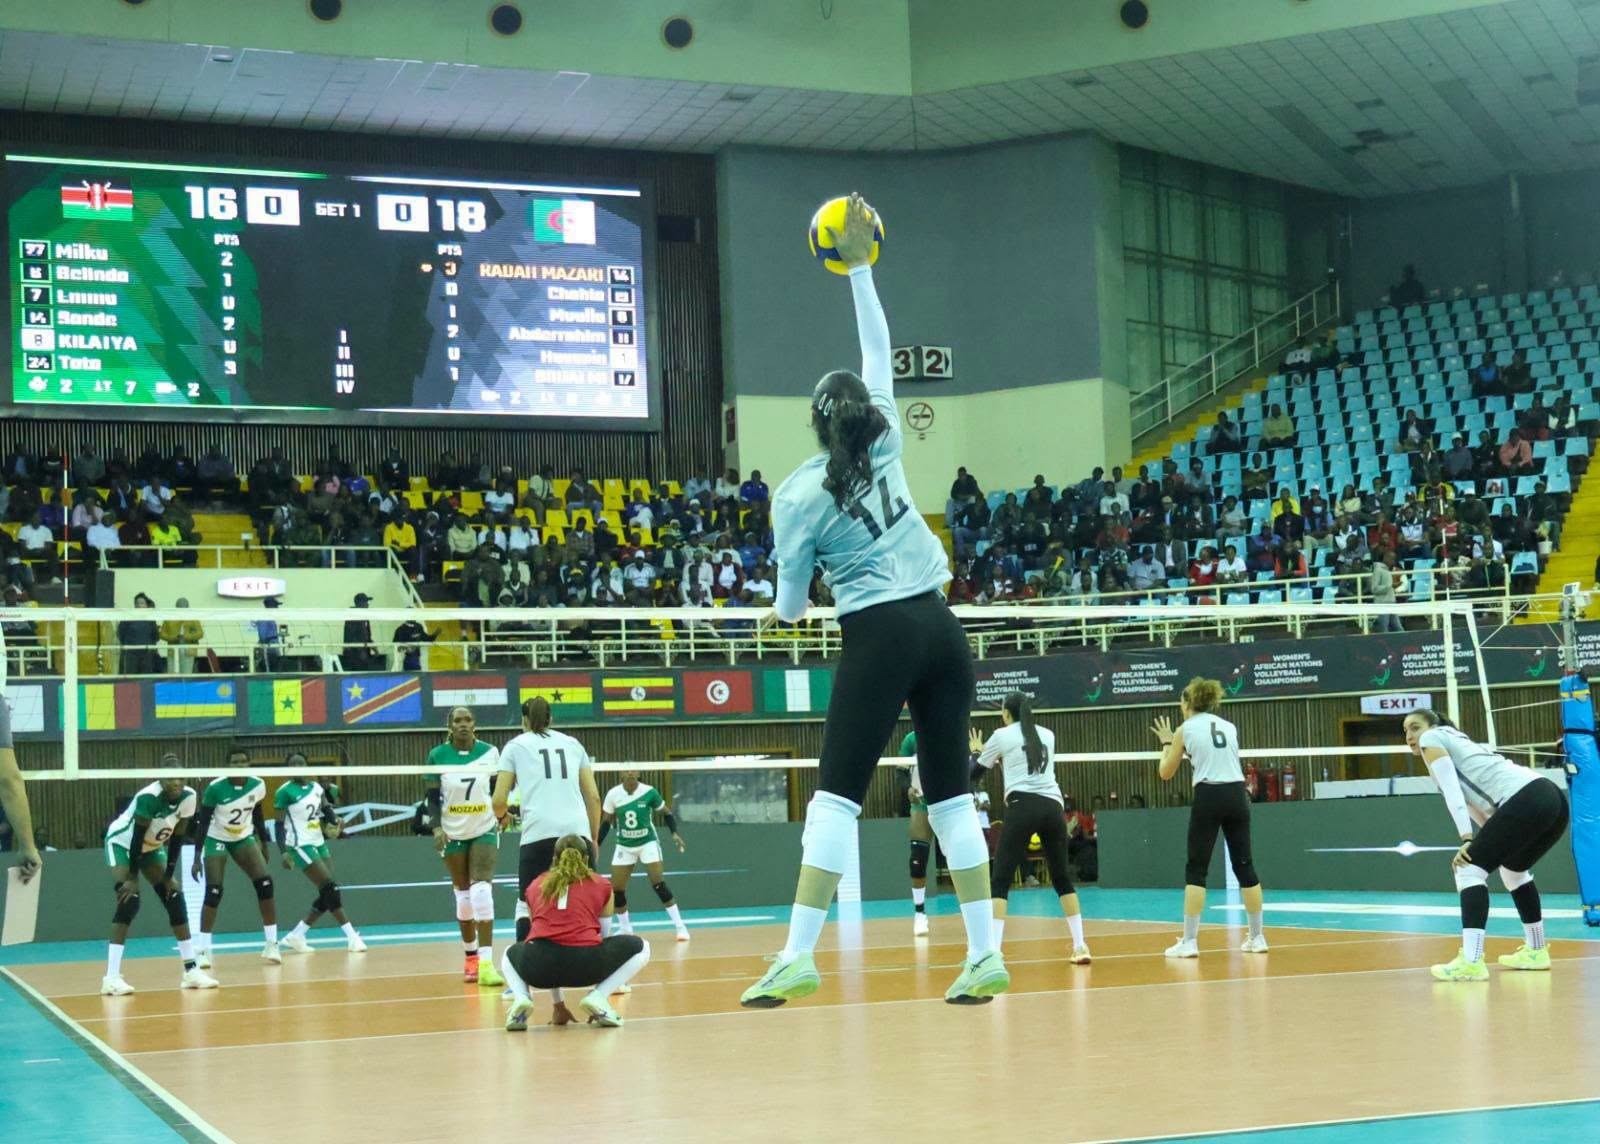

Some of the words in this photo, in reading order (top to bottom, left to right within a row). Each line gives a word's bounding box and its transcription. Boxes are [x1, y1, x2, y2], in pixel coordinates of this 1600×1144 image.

[184, 186, 238, 221] 16
[264, 196, 282, 215] 0
[315, 202, 347, 217] SET
[353, 204, 361, 218] 1
[395, 203, 411, 221] 0
[436, 199, 486, 232] 18
[220, 251, 233, 266] 2
[222, 273, 232, 288] 1
[31, 288, 42, 302] 7
[893, 349, 911, 375] 3
[925, 349, 944, 375] 2
[336, 380, 355, 394] IV
[233, 581, 271, 591] EXIT
[1273, 653, 1311, 661] WOMEN'S
[1402, 652, 1437, 661] AFRICAN
[1130, 662, 1167, 670] WOMEN'S
[1254, 663, 1287, 671] AFRICAN
[1289, 660, 1323, 668] NATIONS
[993, 671, 1028, 679] WOMEN'S
[1146, 669, 1179, 677] NATIONS
[1254, 669, 1303, 677] VOLLEYBALL
[1255, 675, 1319, 685] CHAMPIONSHIPS
[976, 679, 1007, 687] AFRICAN
[1008, 676, 1040, 684] NATIONS
[1112, 678, 1159, 686] VOLLEYBALL
[976, 686, 1020, 694] VOLLEYBALL
[1112, 684, 1174, 694] CHAMPIONSHIPS
[1380, 698, 1418, 709] EXIT
[1211, 722, 1227, 749] 6
[538, 749, 568, 779] 11
[461, 777, 476, 800] 7
[228, 807, 253, 825] 27
[624, 810, 638, 829] 8
[155, 827, 172, 841] 6
